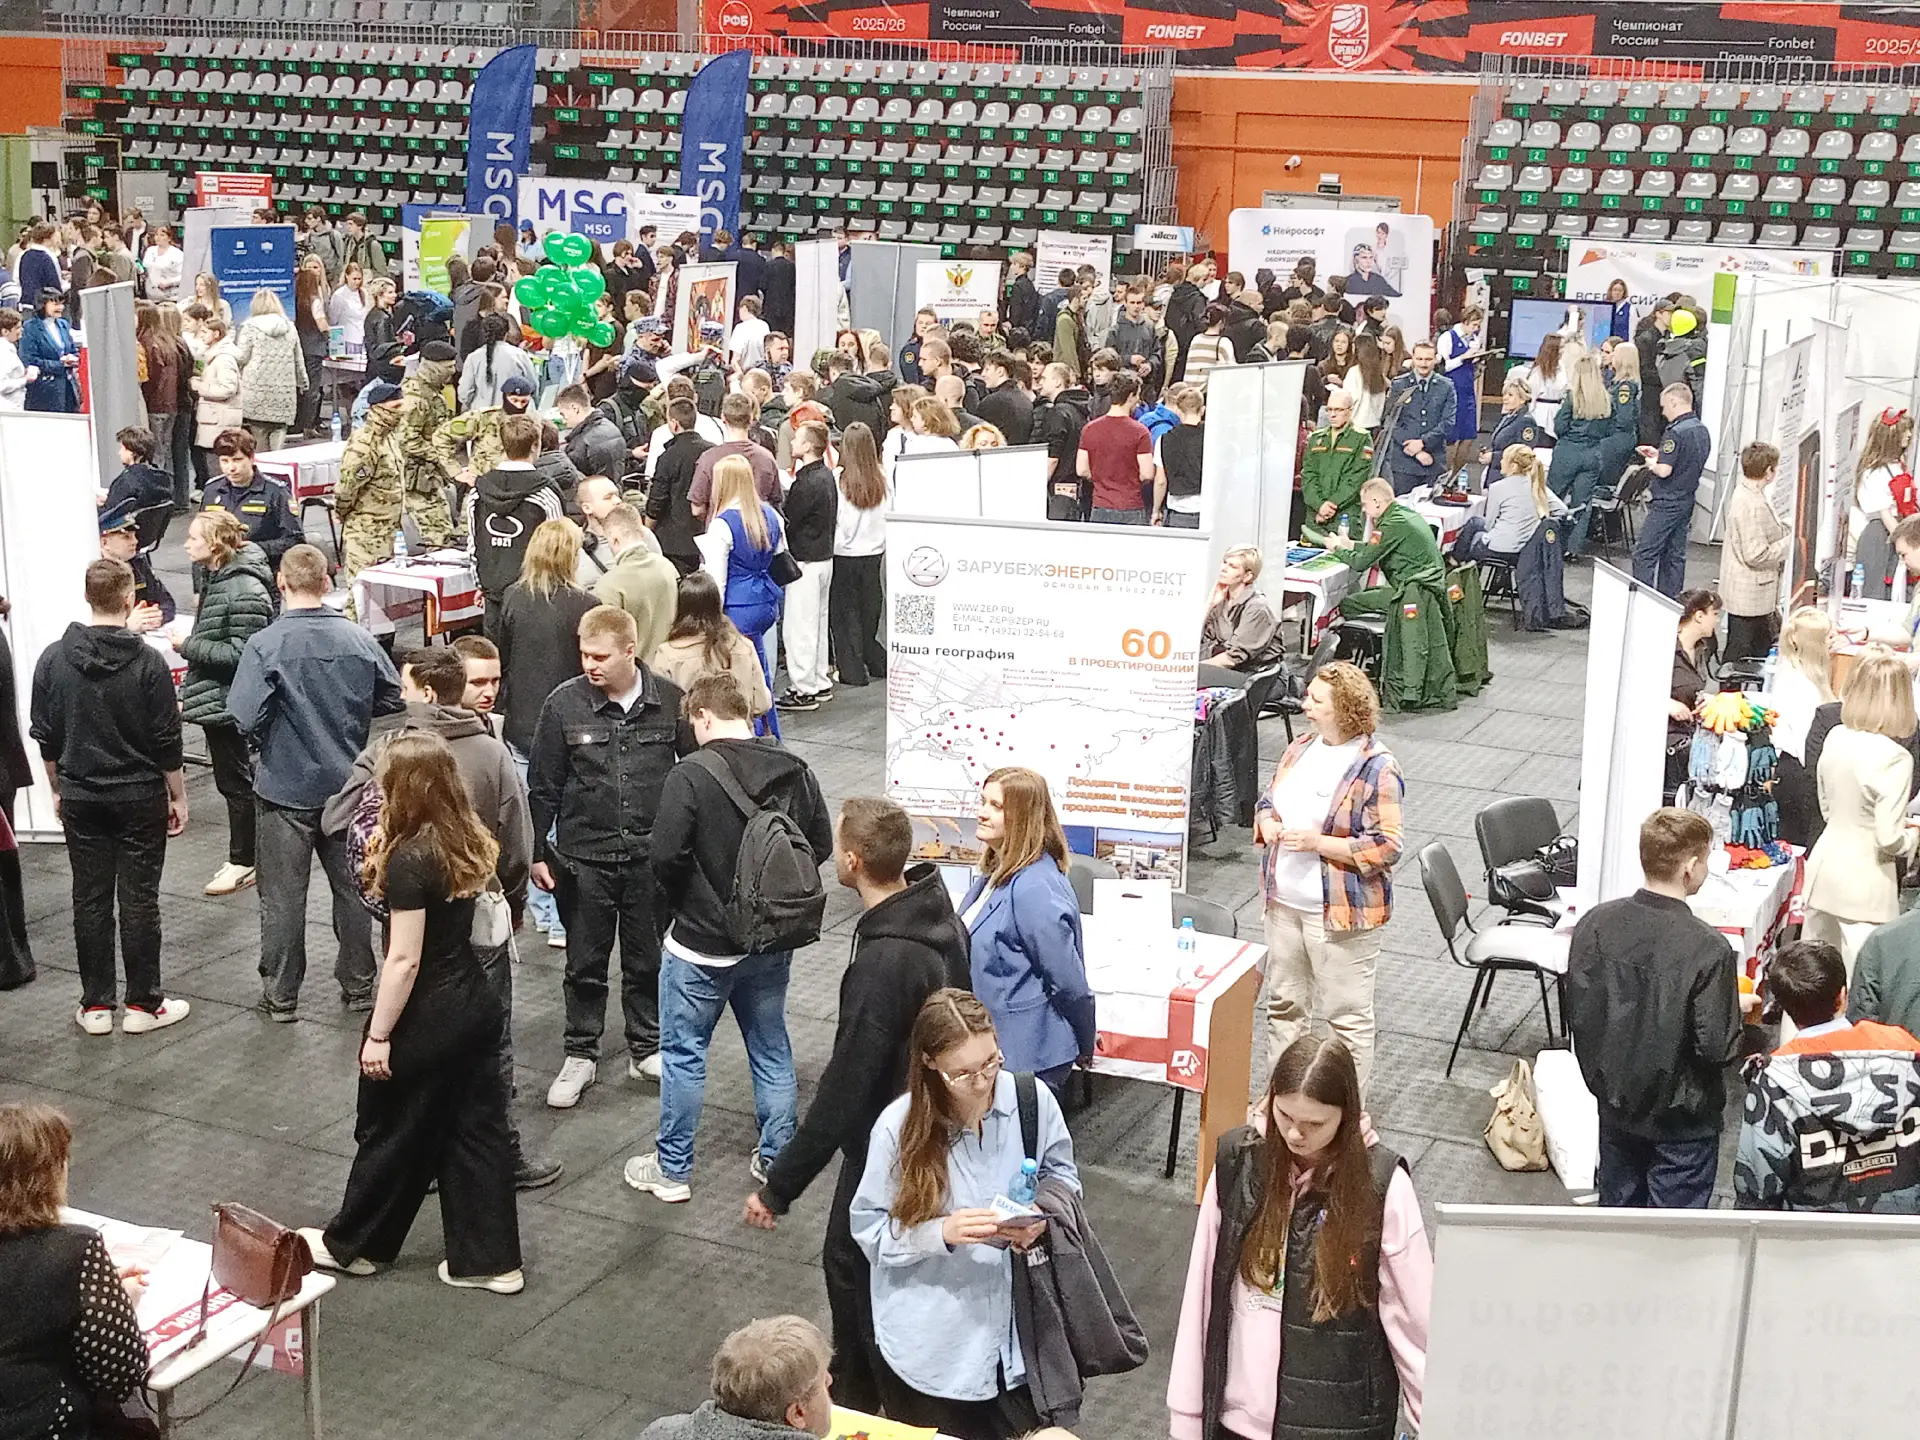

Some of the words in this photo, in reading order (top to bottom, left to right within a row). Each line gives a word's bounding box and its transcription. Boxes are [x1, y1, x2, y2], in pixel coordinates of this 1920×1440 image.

[943, 7, 1000, 19] Чемпионат
[723, 16, 748, 26] РФБ
[852, 17, 906, 32] 2025/26
[1613, 19, 1684, 32] Чемпионат
[942, 20, 982, 31] России
[1069, 24, 1106, 34] Fonbet
[1145, 25, 1206, 39] FONBET
[1500, 31, 1568, 47] FONBET
[1611, 34, 1659, 46] России
[1768, 37, 1815, 50] Fonbet
[1518, 106, 1523, 116] 1
[1594, 109, 1599, 118] 3
[1634, 110, 1640, 119] 4
[1675, 111, 1680, 120] 5
[1715, 112, 1721, 122] 6
[1758, 113, 1763, 122] 7
[1498, 149, 1504, 158] 1
[1533, 151, 1539, 160] 2
[1573, 151, 1581, 161] 3
[1614, 153, 1622, 163] 4
[1655, 155, 1663, 164] 5
[1696, 156, 1705, 166] 6
[1740, 157, 1748, 167] 7
[1783, 159, 1791, 169] 8
[1827, 161, 1834, 171] 9
[1869, 163, 1878, 172] 10
[696, 142, 727, 235] MSG
[1486, 192, 1494, 202] 1
[1527, 194, 1534, 204] 2
[1566, 195, 1573, 205] 3
[1608, 197, 1614, 206] 4
[538, 188, 627, 221] MSG
[1648, 199, 1655, 208] 5
[1732, 202, 1740, 212] 7
[1775, 204, 1782, 214] 8
[1819, 207, 1827, 216] 9
[1862, 209, 1871, 218] 10
[1907, 211, 1916, 220] 11
[584, 223, 612, 235] MSG
[1273, 226, 1325, 236] Нейрософт
[1483, 235, 1490, 245] 1
[1521, 237, 1529, 246] 2
[1855, 254, 1865, 263] 10
[1901, 256, 1912, 265] 11
[1517, 279, 1525, 289] 2
[491, 537, 512, 548] COZY
[957, 559, 1186, 586] ЗАРУБЕЖЭНЕРГОПРОЕКТ
[1121, 628, 1172, 660] 60
[1172, 651, 1196, 661] ЛЕТ
[891, 641, 930, 656] Наша
[935, 647, 1015, 661] география
[1069, 657, 1077, 666] В
[1081, 658, 1195, 673] ПРОЕКТИРОВАНИИ
